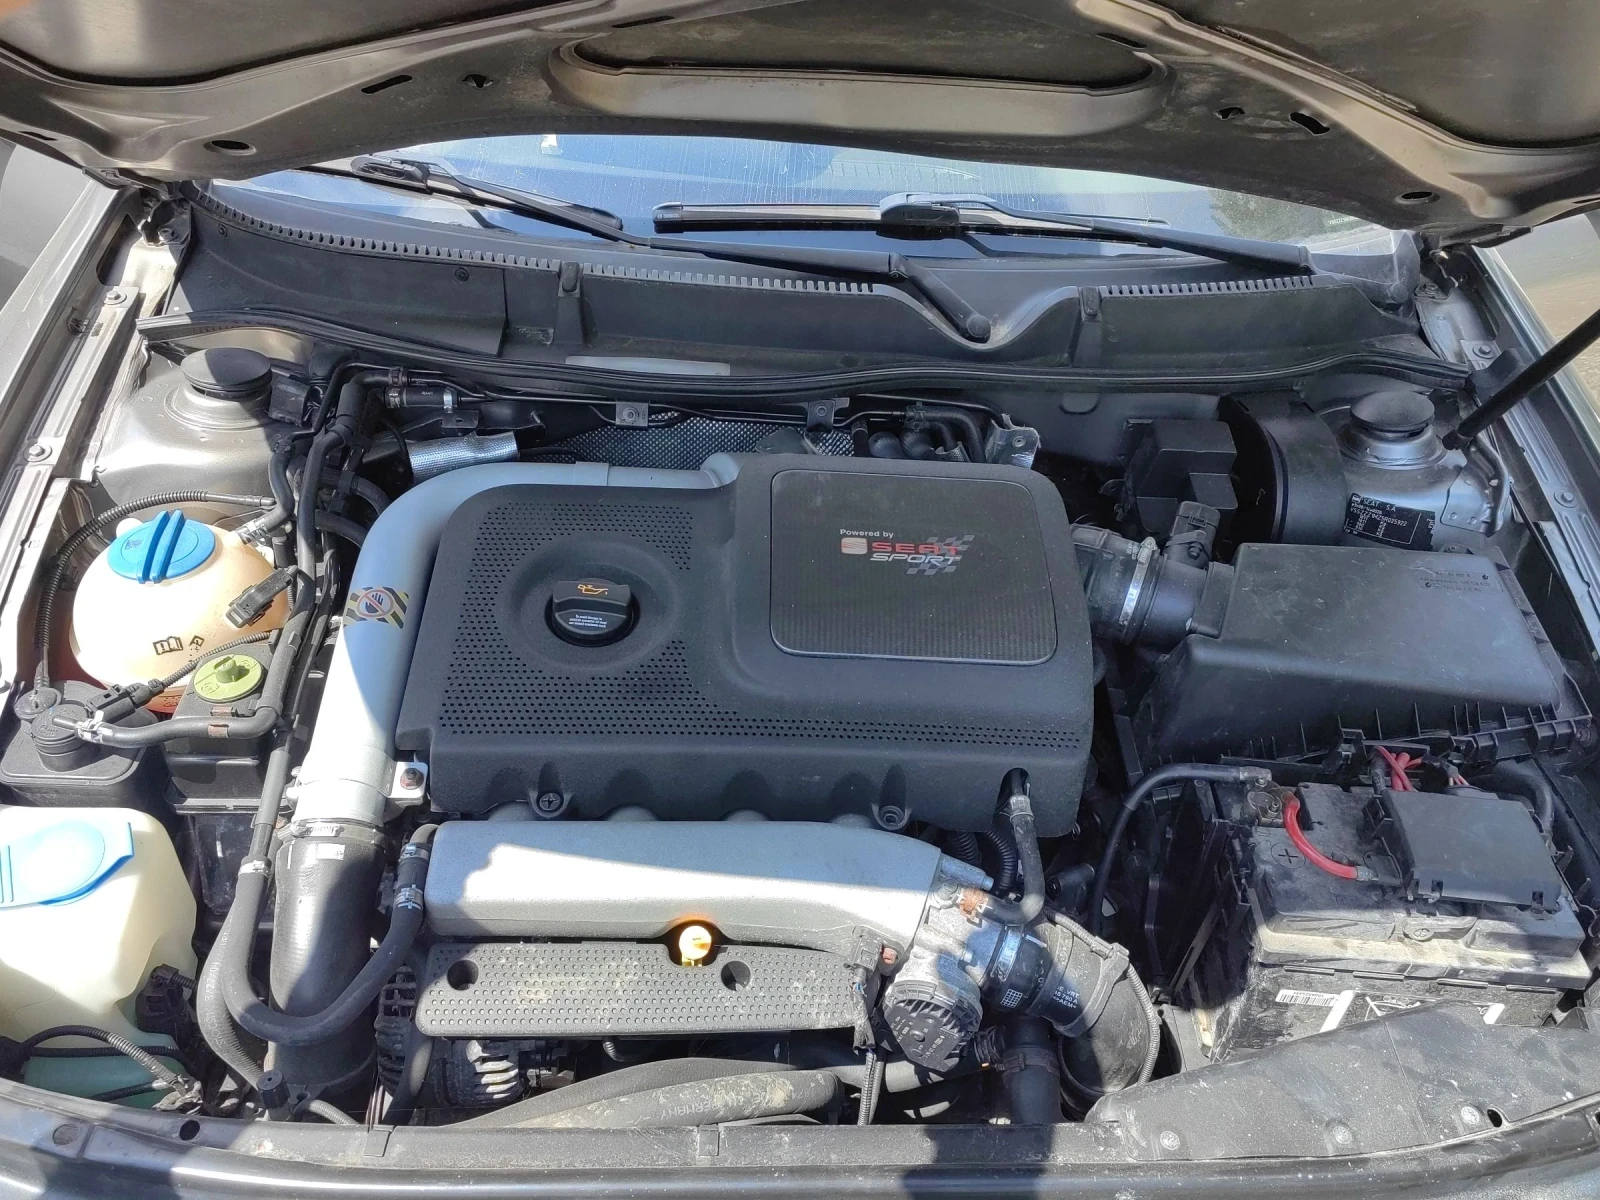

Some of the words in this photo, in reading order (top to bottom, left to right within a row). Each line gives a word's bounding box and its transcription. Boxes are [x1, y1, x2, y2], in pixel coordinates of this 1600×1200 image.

[840, 529, 880, 537] Powered
[883, 530, 894, 538] by
[872, 542, 957, 555] SEAT
[870, 553, 962, 566] SPORT
